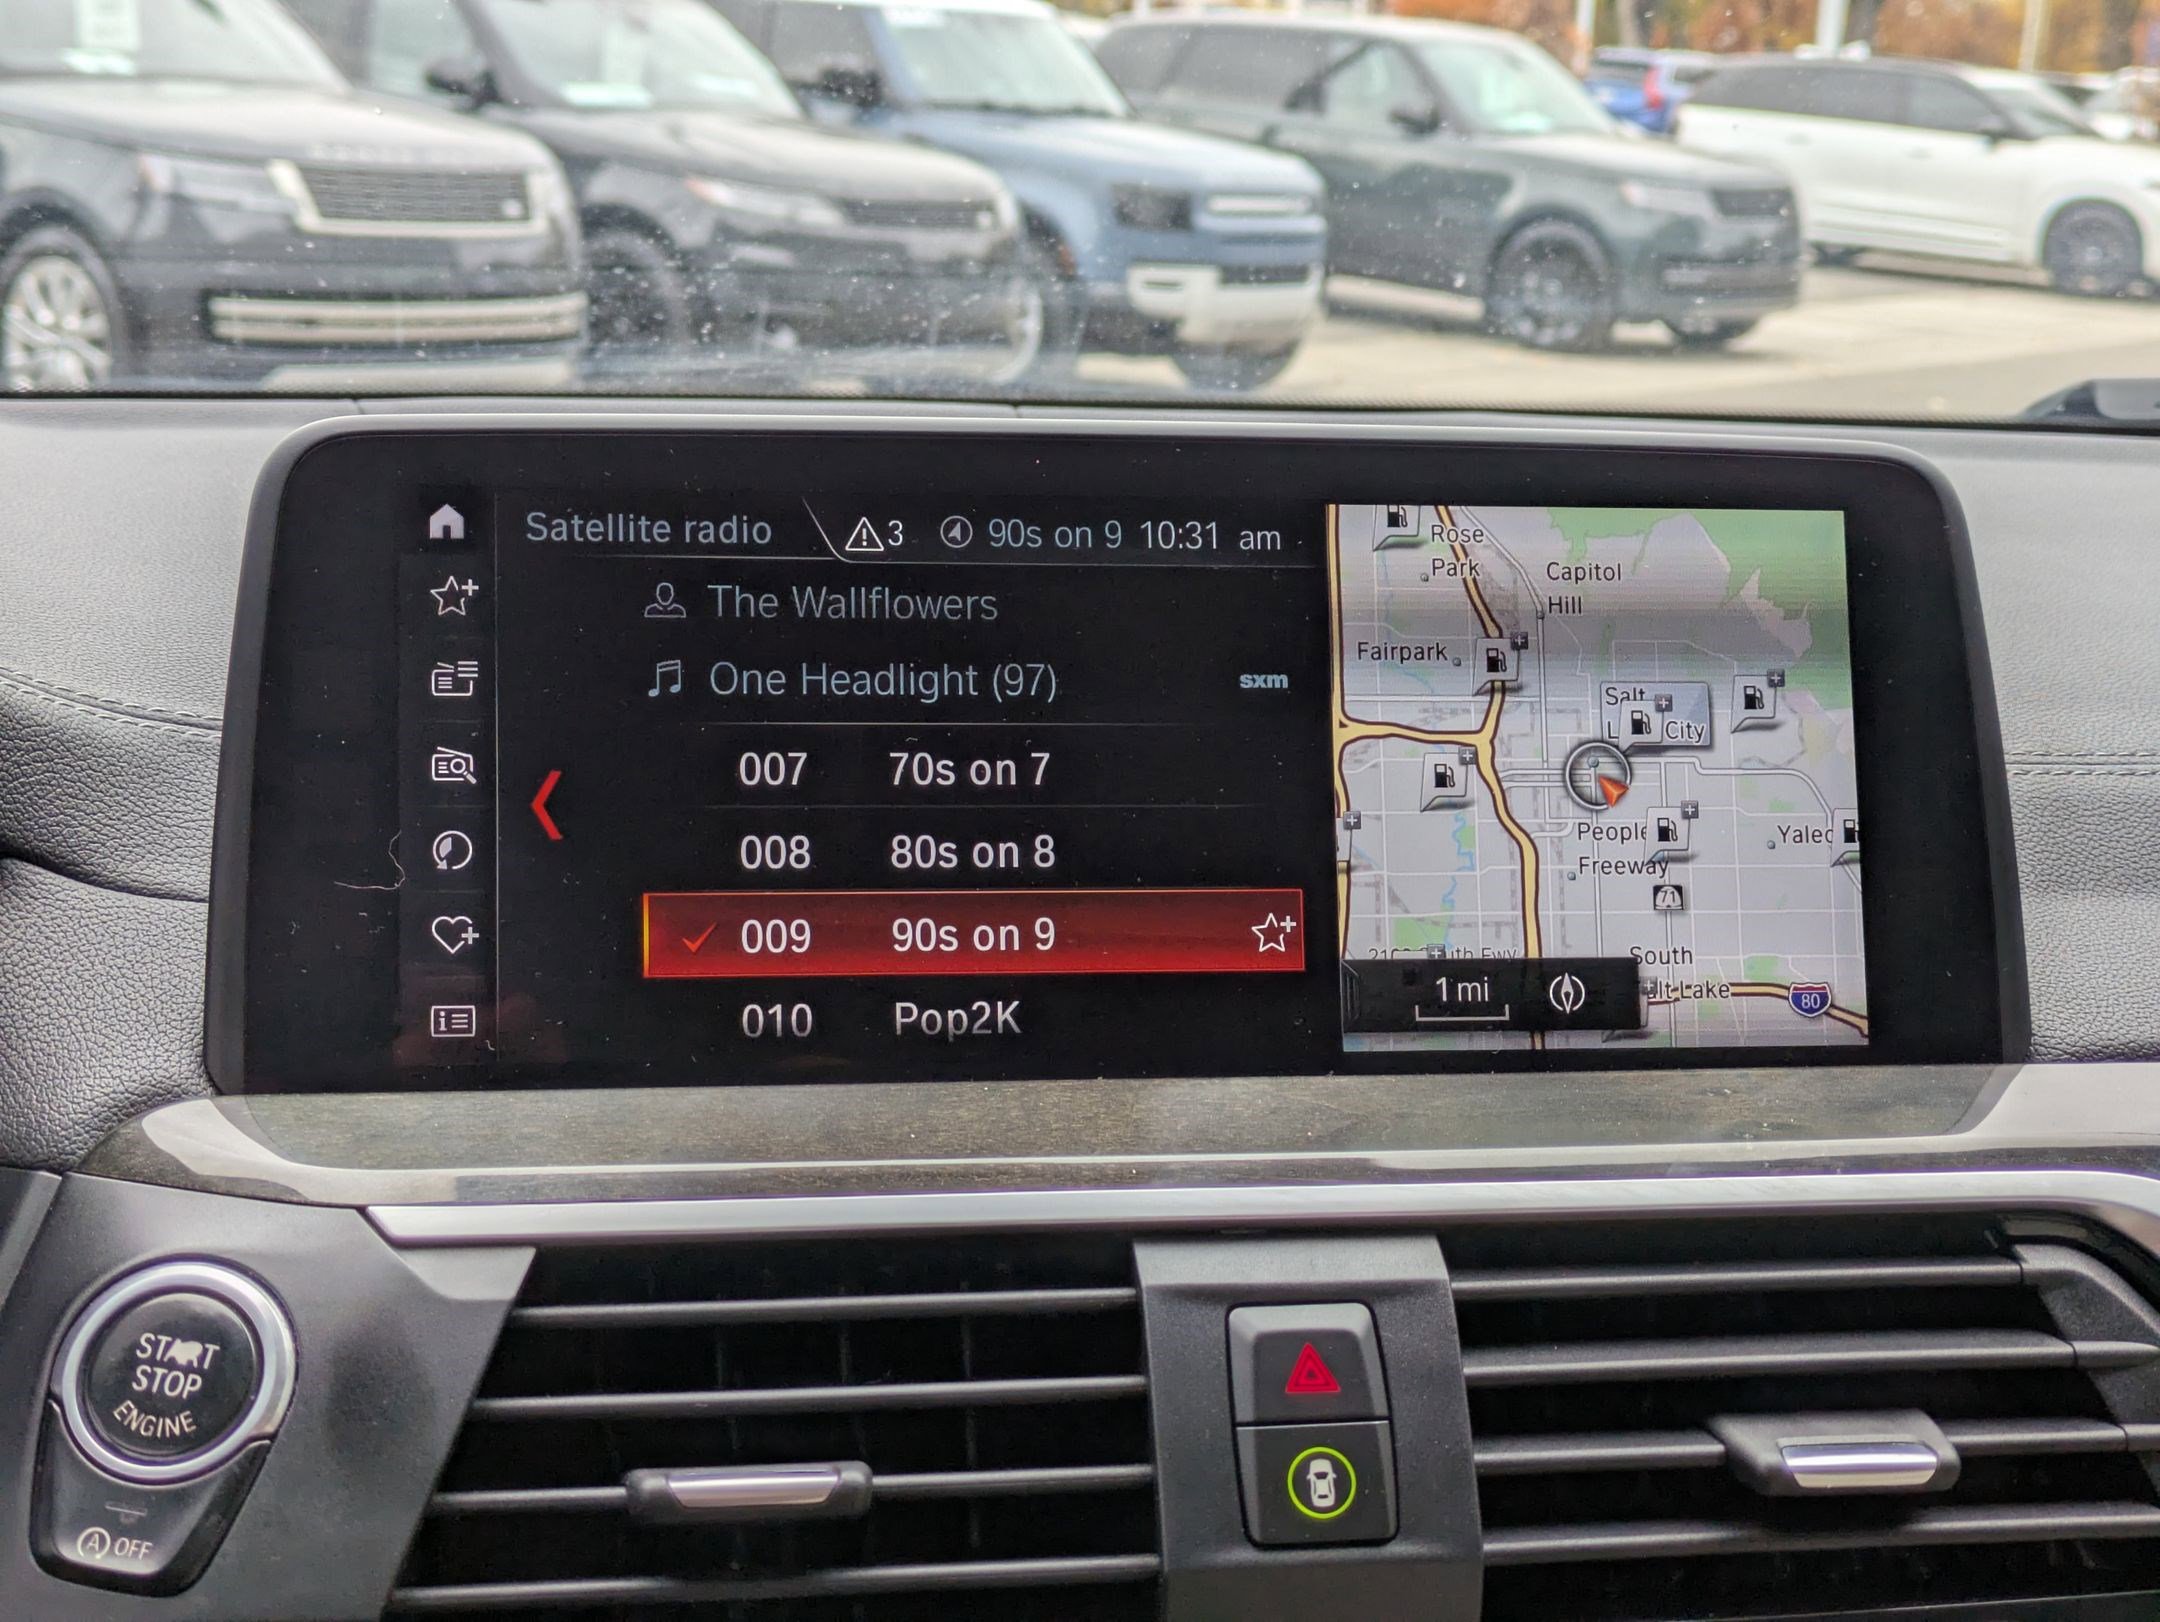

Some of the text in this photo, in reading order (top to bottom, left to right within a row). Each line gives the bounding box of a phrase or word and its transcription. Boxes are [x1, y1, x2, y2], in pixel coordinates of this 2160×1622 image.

[526, 511, 772, 545] Satellite radio
[888, 520, 903, 546] 3
[988, 518, 1122, 549] 90s on 9
[1140, 520, 1281, 551] 10:31 am
[1431, 524, 1484, 543] Rose
[1432, 558, 1480, 577] Park
[1546, 562, 1622, 585] Capitol
[707, 584, 998, 620] The Wallflowers
[1548, 596, 1583, 614] Hill
[1357, 641, 1448, 664] Fairpark
[710, 661, 1057, 704] One Headlight (97)
[1239, 673, 1289, 689] sxm
[1665, 720, 1705, 743] City
[739, 751, 1050, 786] 007 70s on 7
[740, 834, 1056, 870] 008 80s on 8
[1579, 857, 1669, 879] Freeway
[1659, 890, 1675, 904] 71
[741, 916, 1055, 954] 009 90s on 9
[1629, 946, 1693, 965] South
[1435, 976, 1489, 1002] 1 mi
[1680, 980, 1730, 998] Lake
[1801, 993, 1821, 1009] 80
[742, 1000, 1022, 1042] 010 Pop2K
[132, 1364, 202, 1399] STOP
[113, 1400, 197, 1438] ENGINE
[114, 1537, 153, 1560] OFF
